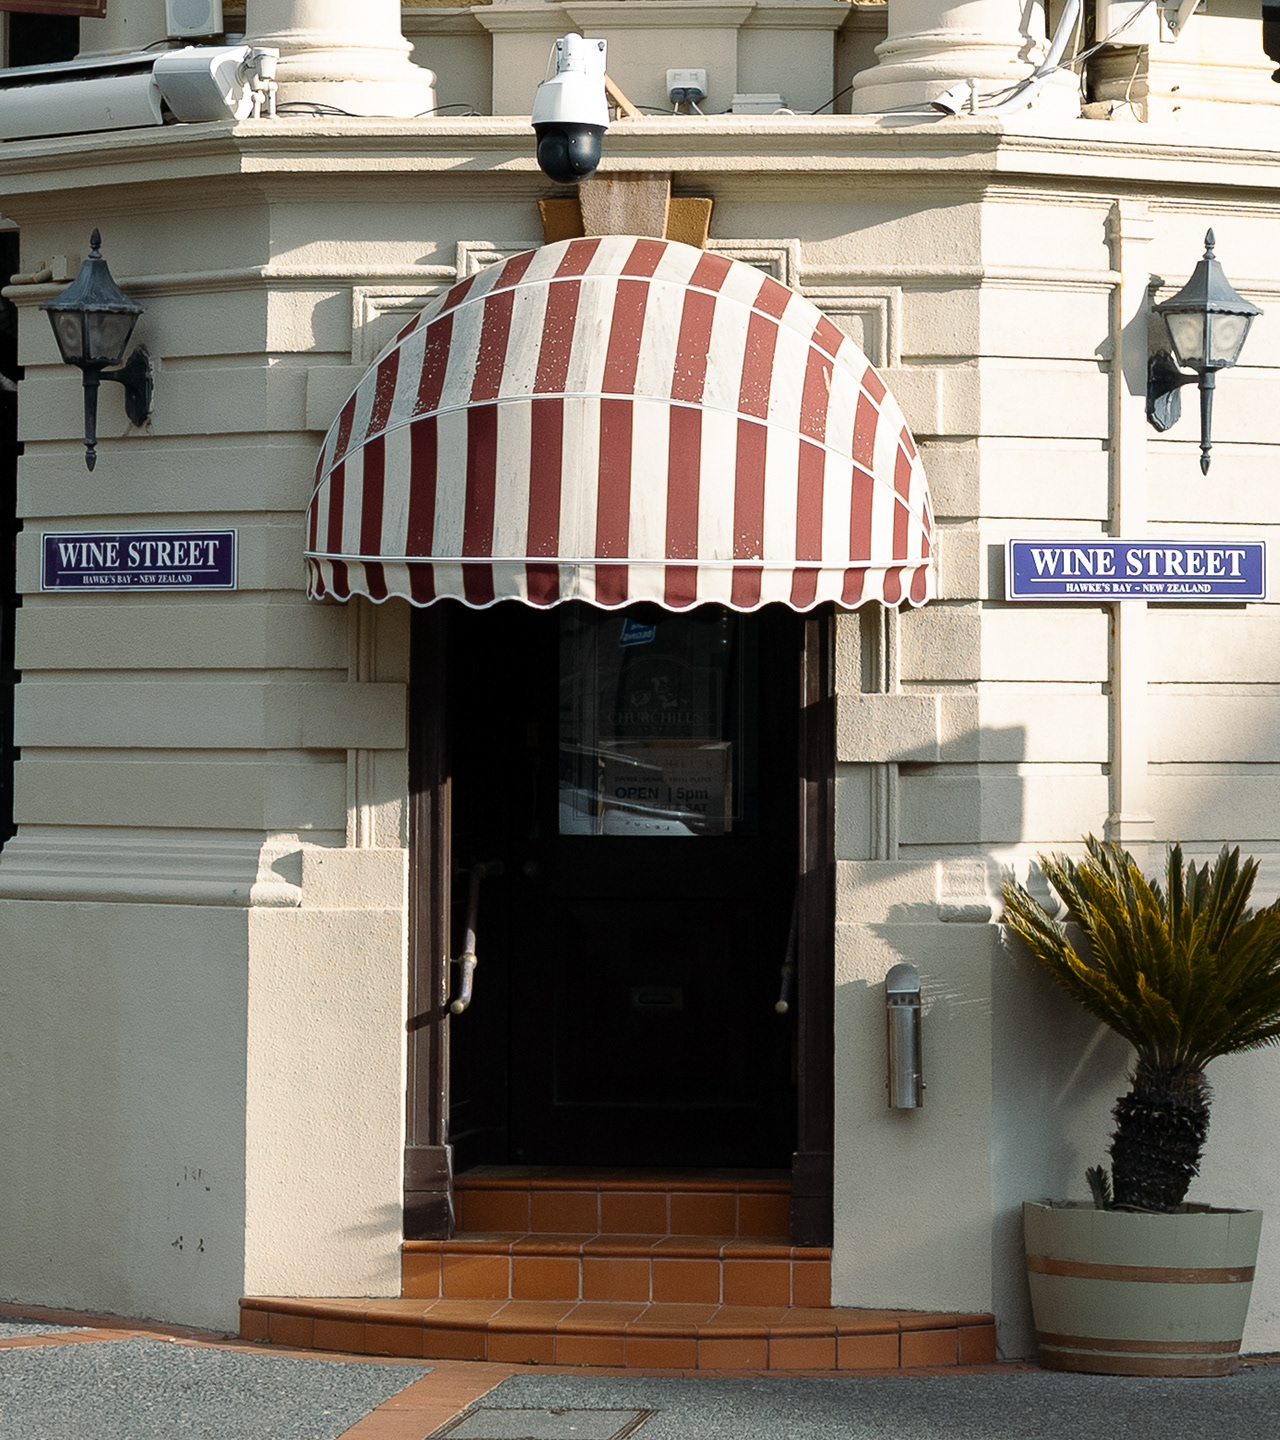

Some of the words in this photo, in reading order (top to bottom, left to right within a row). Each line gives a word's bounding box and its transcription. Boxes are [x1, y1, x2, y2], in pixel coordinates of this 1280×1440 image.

[58, 542, 120, 568] WINE
[127, 540, 219, 567] STREET
[1030, 548, 1116, 576] WINE
[1125, 548, 1246, 576] STREET
[82, 575, 116, 584] HAWKE'S
[117, 575, 132, 584] BAY
[139, 575, 157, 583] NEW
[158, 574, 193, 583] ZEALAND
[1065, 583, 1111, 593] HAWKE'S
[1112, 583, 1132, 593] BAY
[1142, 583, 1165, 593] NEW
[1166, 583, 1212, 593] ZEALAND
[615, 787, 659, 800] OPEN
[676, 787, 709, 803] 5pm
[686, 803, 708, 812] SAT
